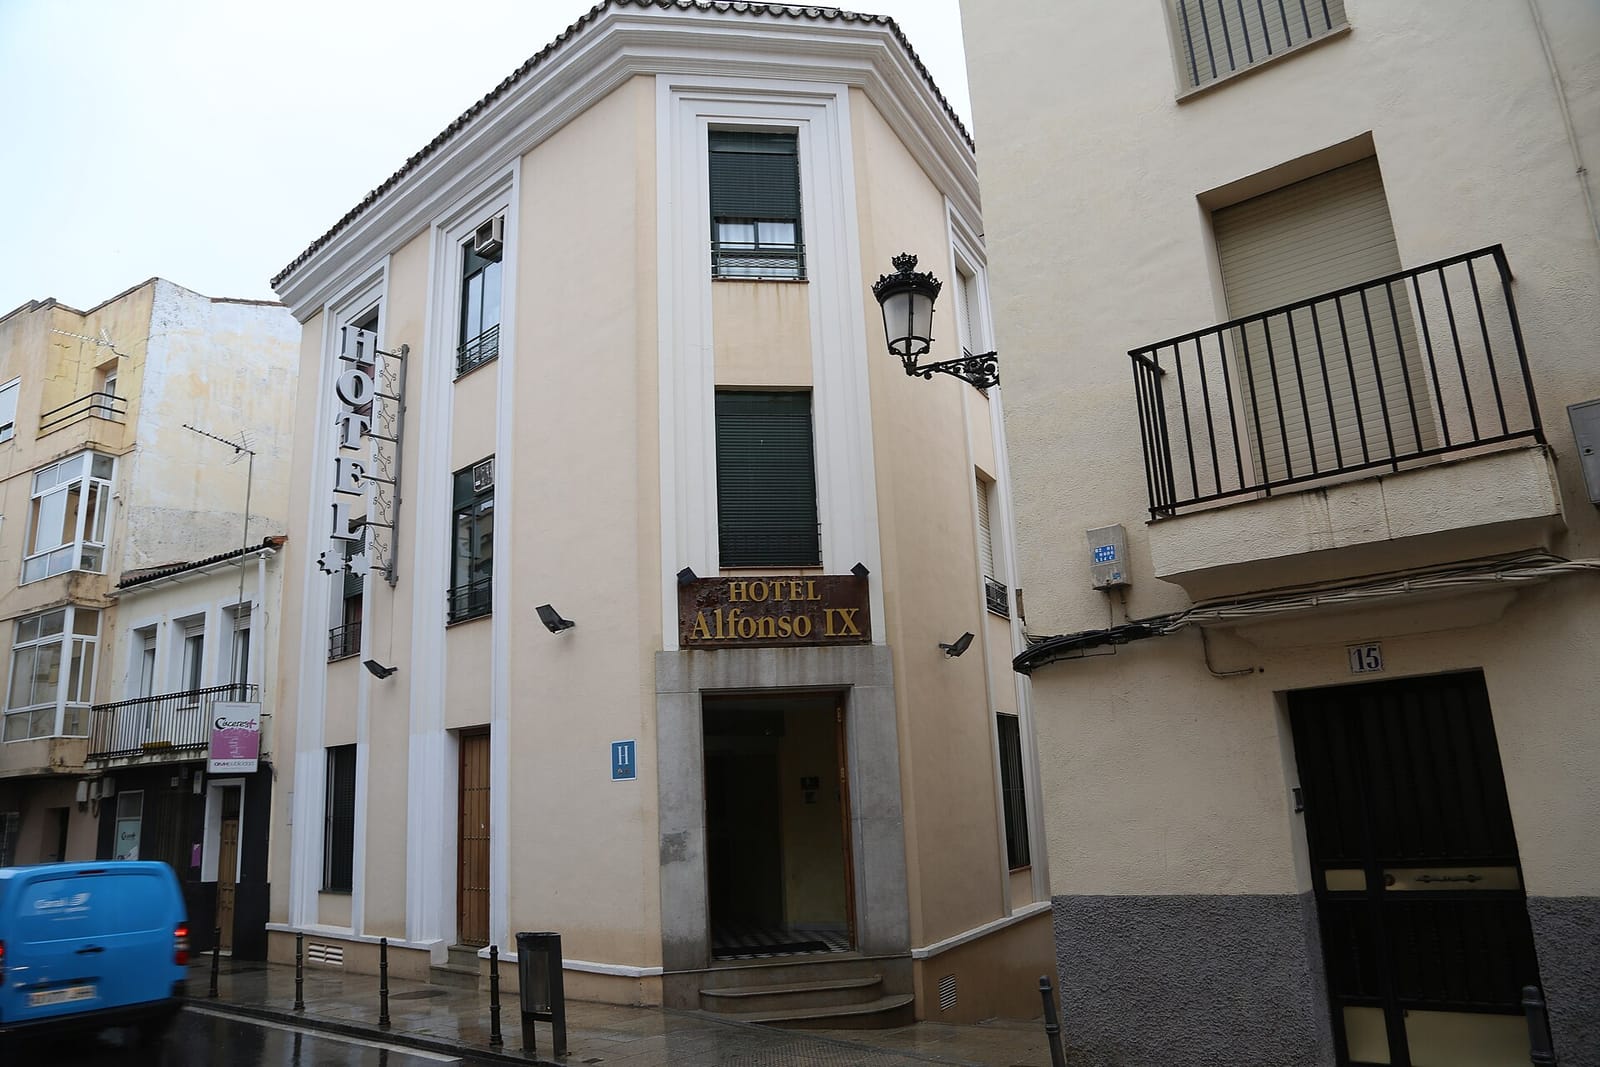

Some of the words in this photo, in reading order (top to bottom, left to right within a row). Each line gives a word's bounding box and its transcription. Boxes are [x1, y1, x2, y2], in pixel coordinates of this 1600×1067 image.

[330, 324, 377, 541] HOTEL
[728, 580, 822, 603] HOTEL
[689, 608, 813, 641] Alfonso
[823, 607, 862, 637] IX
[1352, 647, 1380, 670] 15
[617, 745, 629, 766] H
